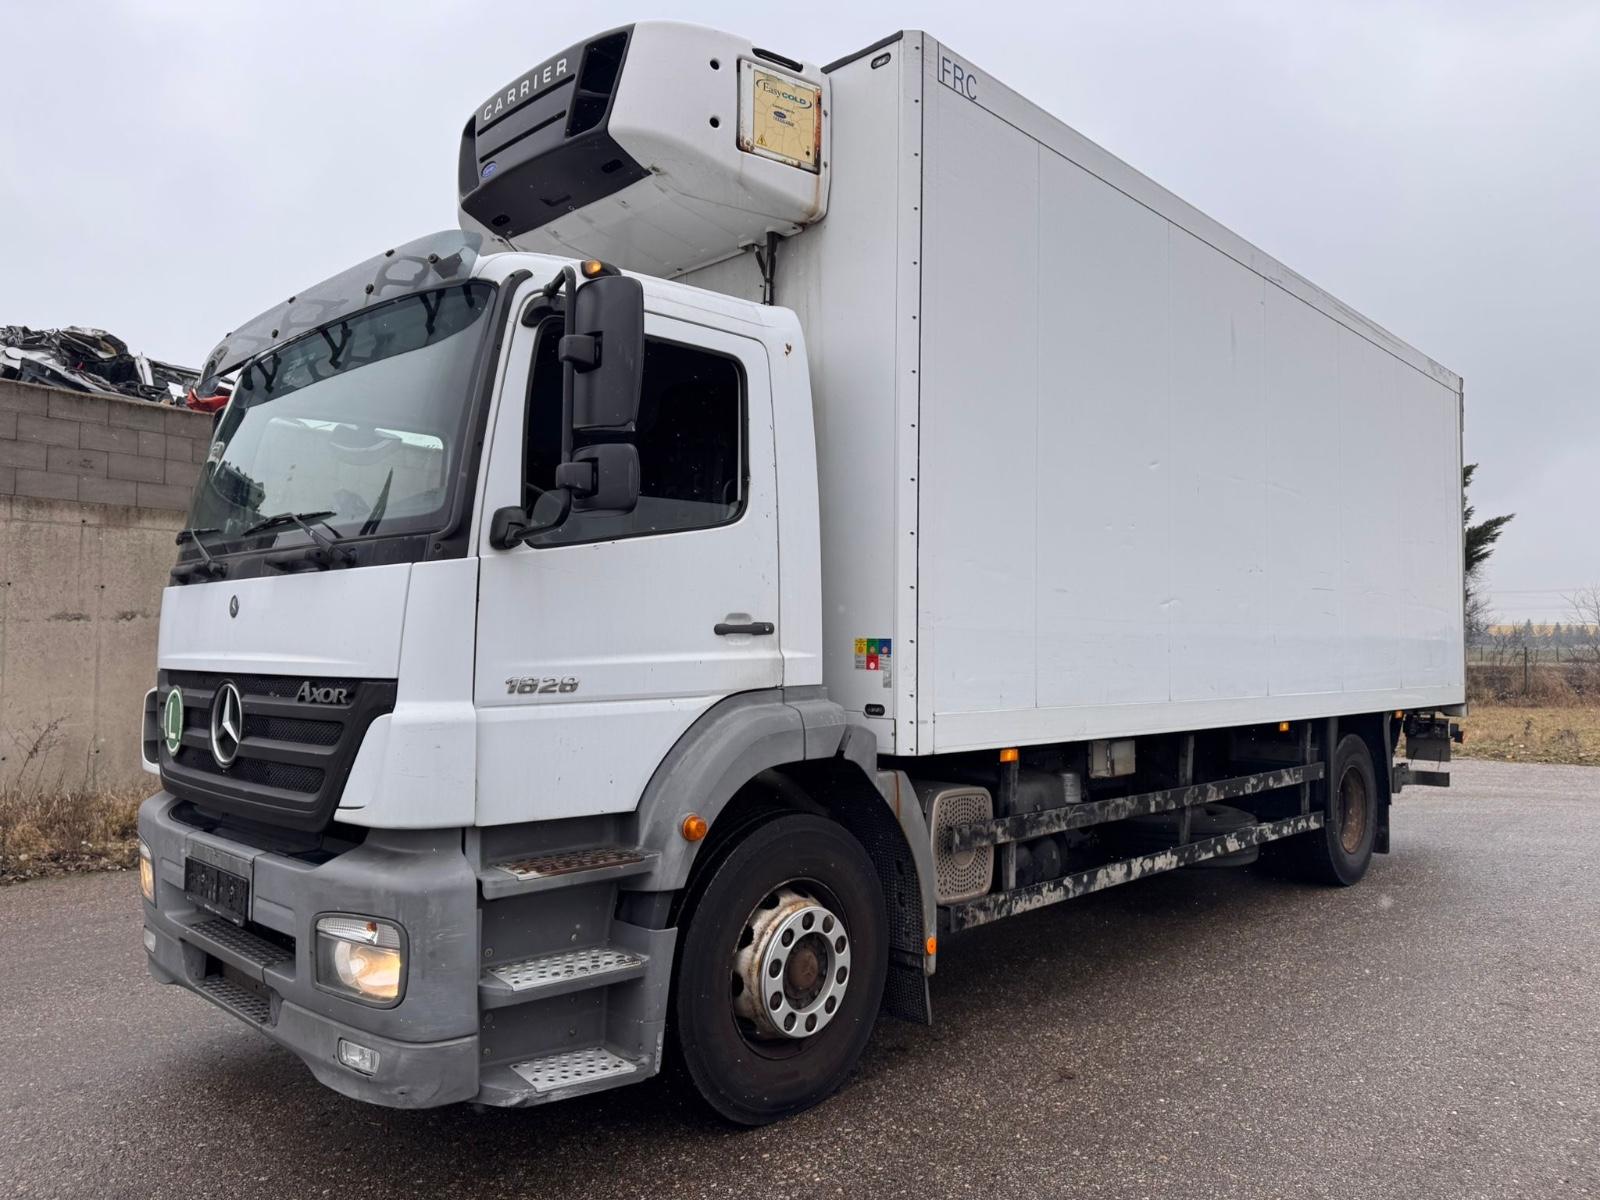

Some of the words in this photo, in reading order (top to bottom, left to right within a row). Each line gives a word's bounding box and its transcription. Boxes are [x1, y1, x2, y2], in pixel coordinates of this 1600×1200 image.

[484, 58, 567, 121] CARRIER
[942, 56, 977, 100] FRC
[505, 677, 579, 694] 1828
[168, 702, 177, 739] L
